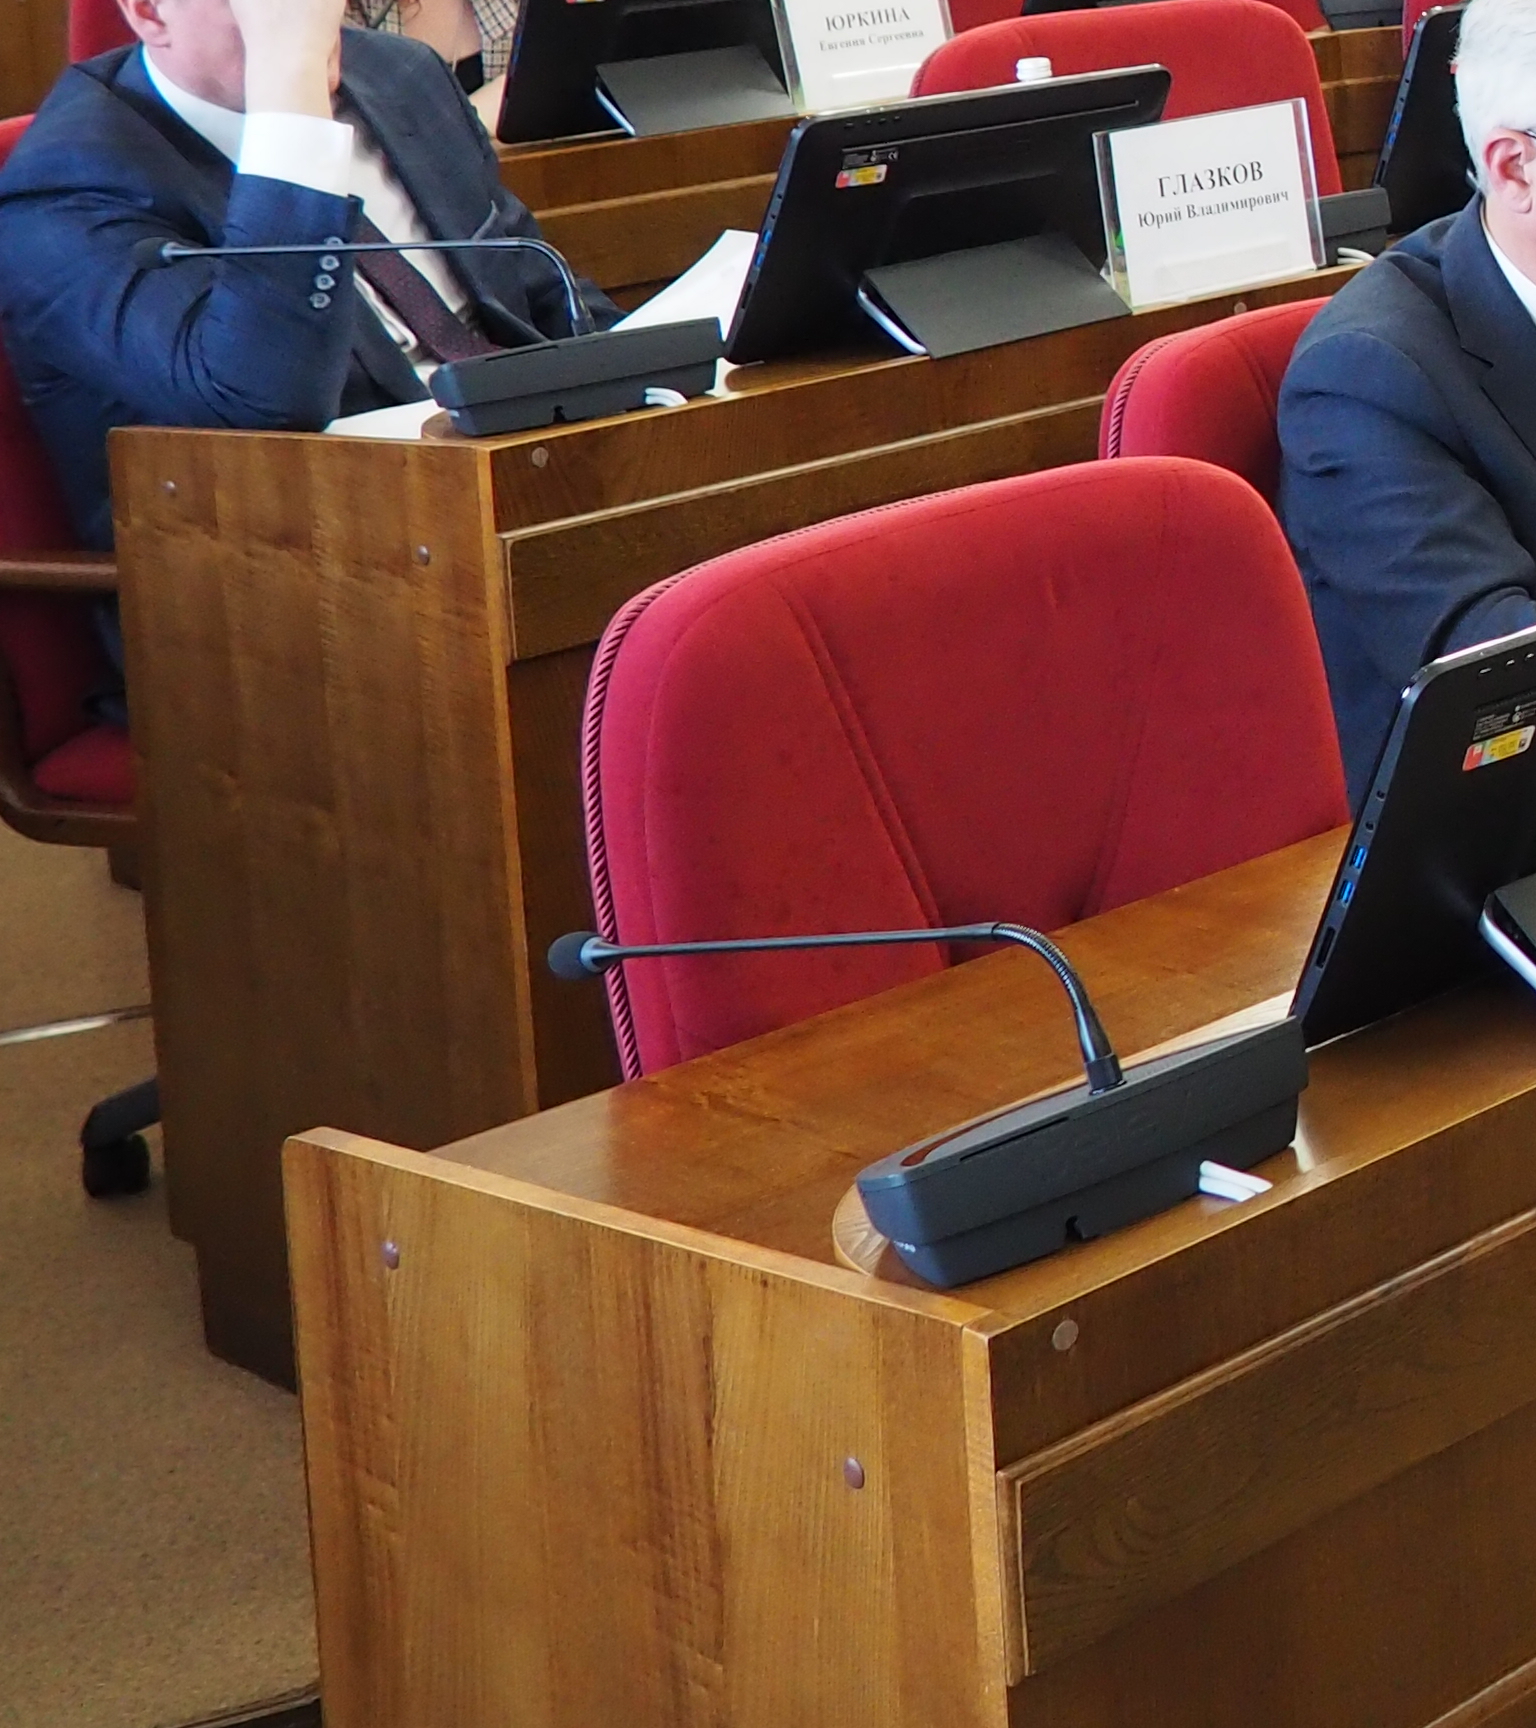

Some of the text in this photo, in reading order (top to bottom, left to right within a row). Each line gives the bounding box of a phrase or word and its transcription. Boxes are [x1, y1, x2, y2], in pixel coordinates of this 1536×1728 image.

[825, 7, 911, 32] ЮРКИНА
[819, 29, 925, 52] Евгения Сергеевна
[1158, 160, 1264, 198] ГЛАЗКОВ
[1137, 191, 1289, 229] Юрий Владимирович
